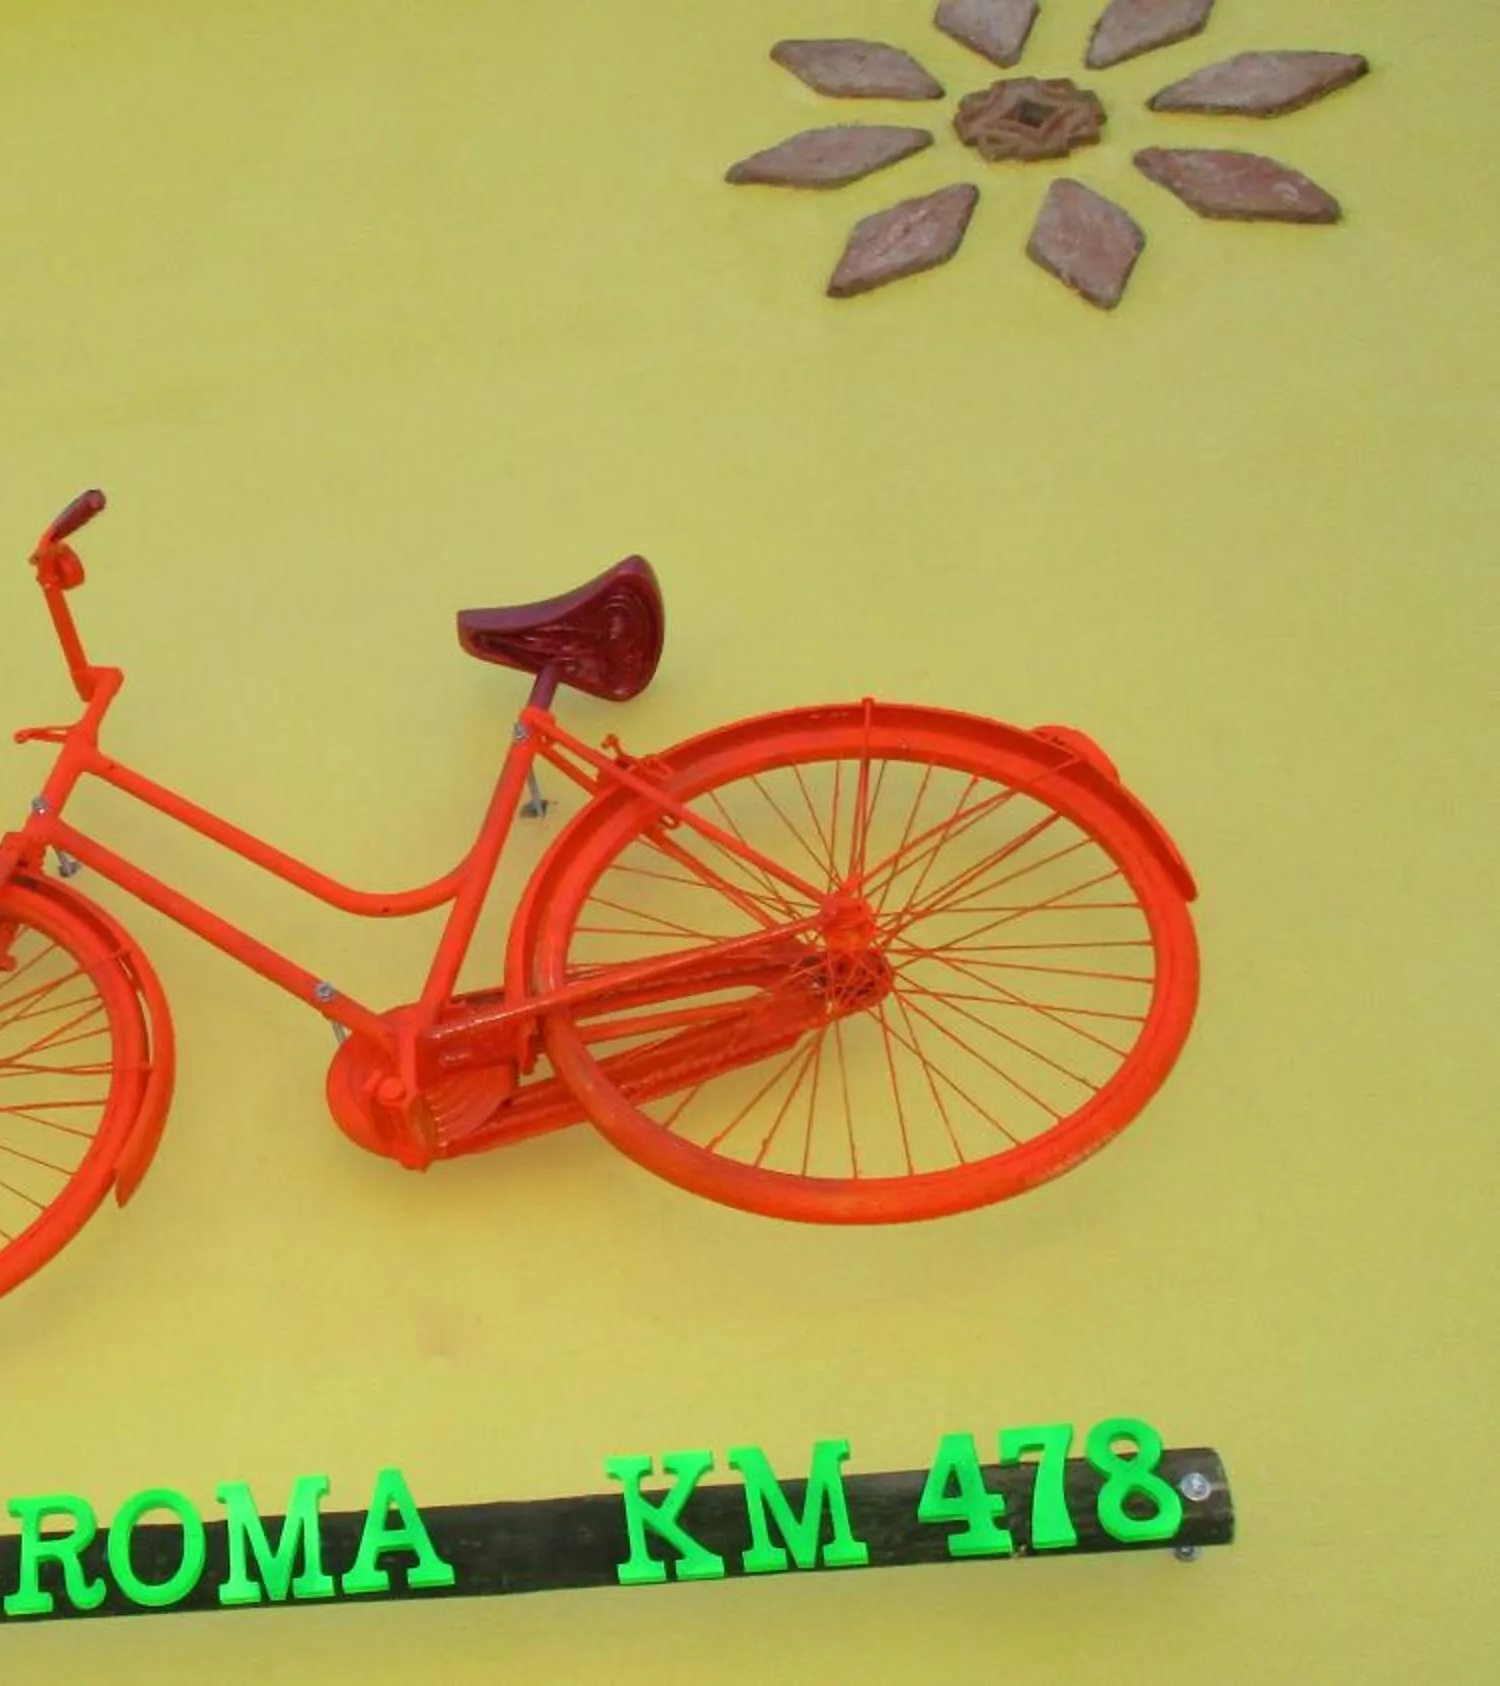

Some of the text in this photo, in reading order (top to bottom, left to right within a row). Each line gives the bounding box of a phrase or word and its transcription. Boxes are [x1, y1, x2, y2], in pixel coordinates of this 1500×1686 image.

[3, 1417, 1184, 1616] ROMA KM 478
